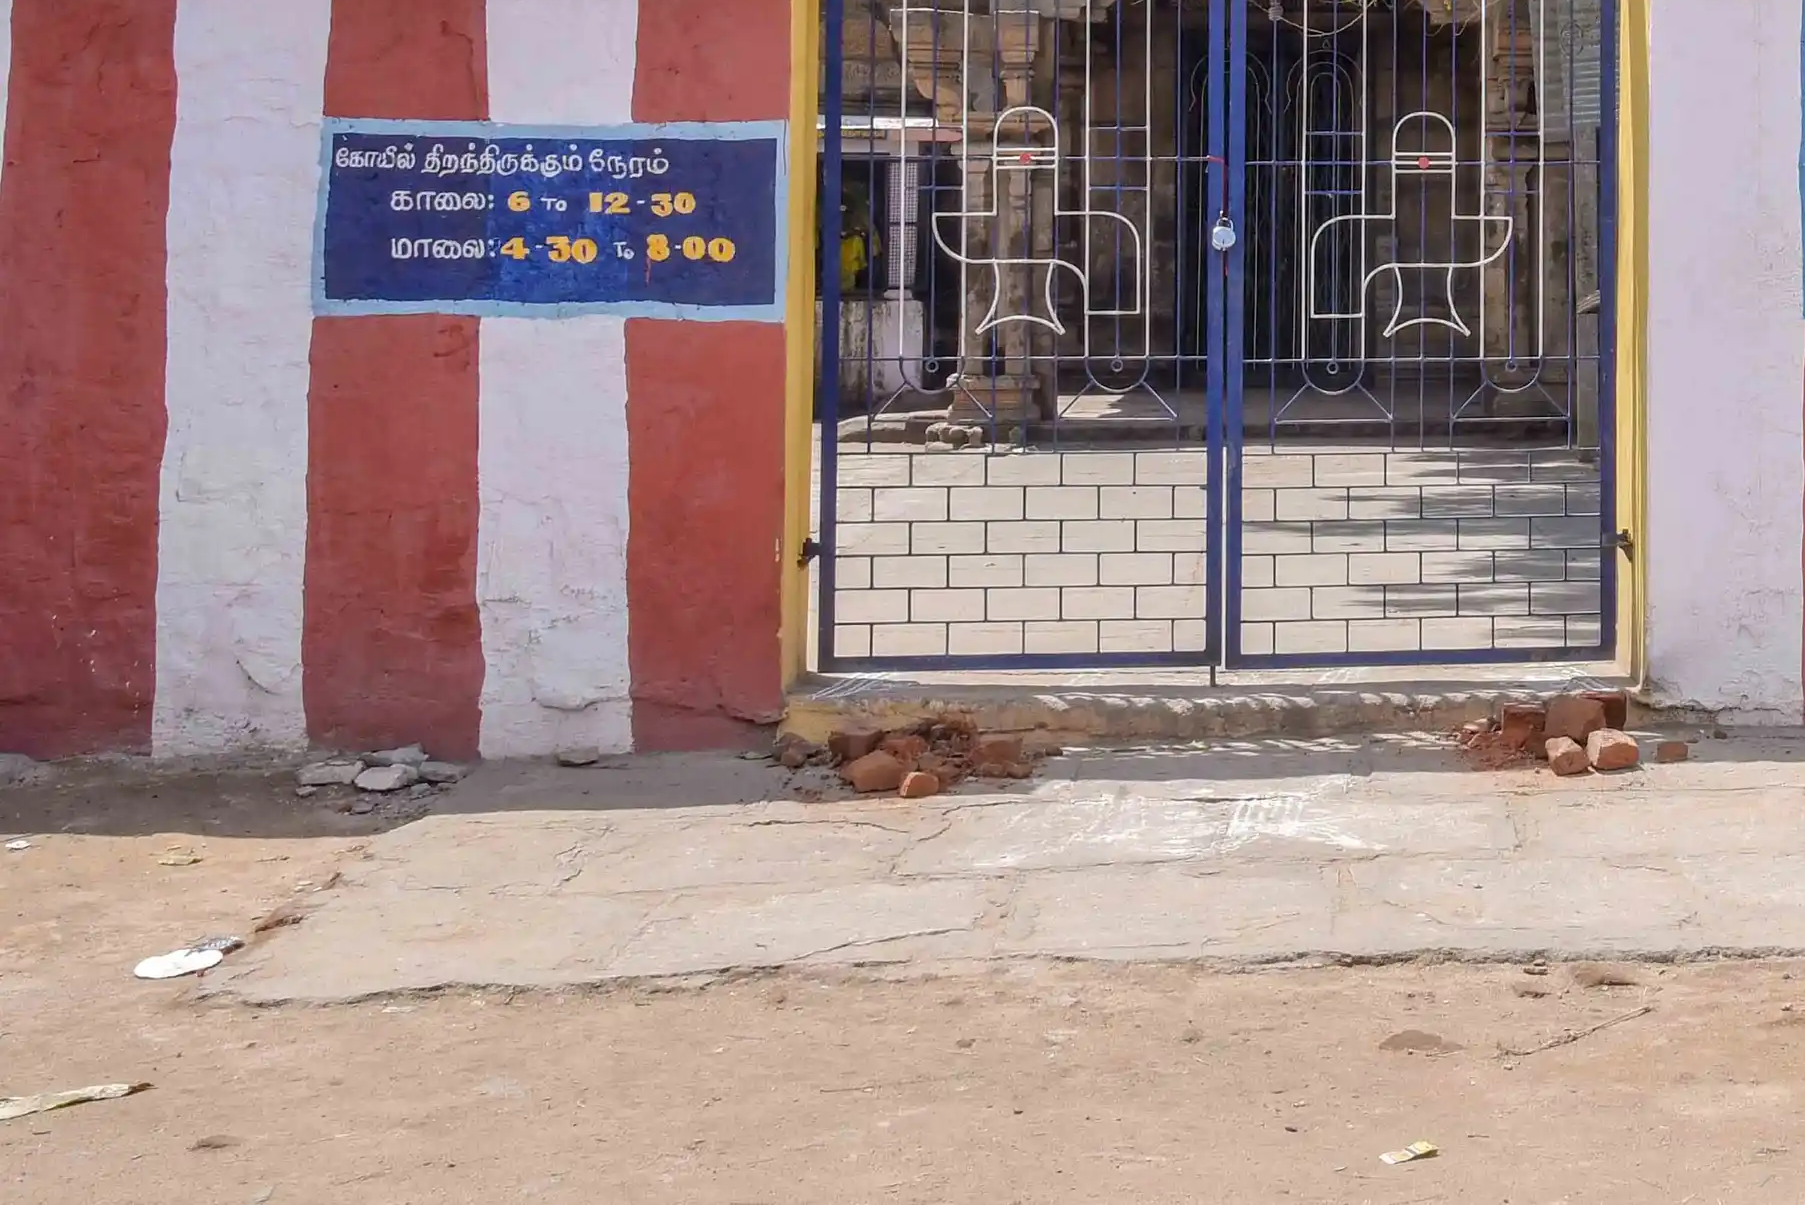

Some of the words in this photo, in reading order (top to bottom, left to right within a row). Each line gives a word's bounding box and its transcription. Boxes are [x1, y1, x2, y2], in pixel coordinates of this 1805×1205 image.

[335, 142, 416, 170] கோயில்
[420, 143, 583, 178] திறந்திருக்கும்
[588, 147, 670, 179] நேரம்
[507, 191, 531, 213] 6
